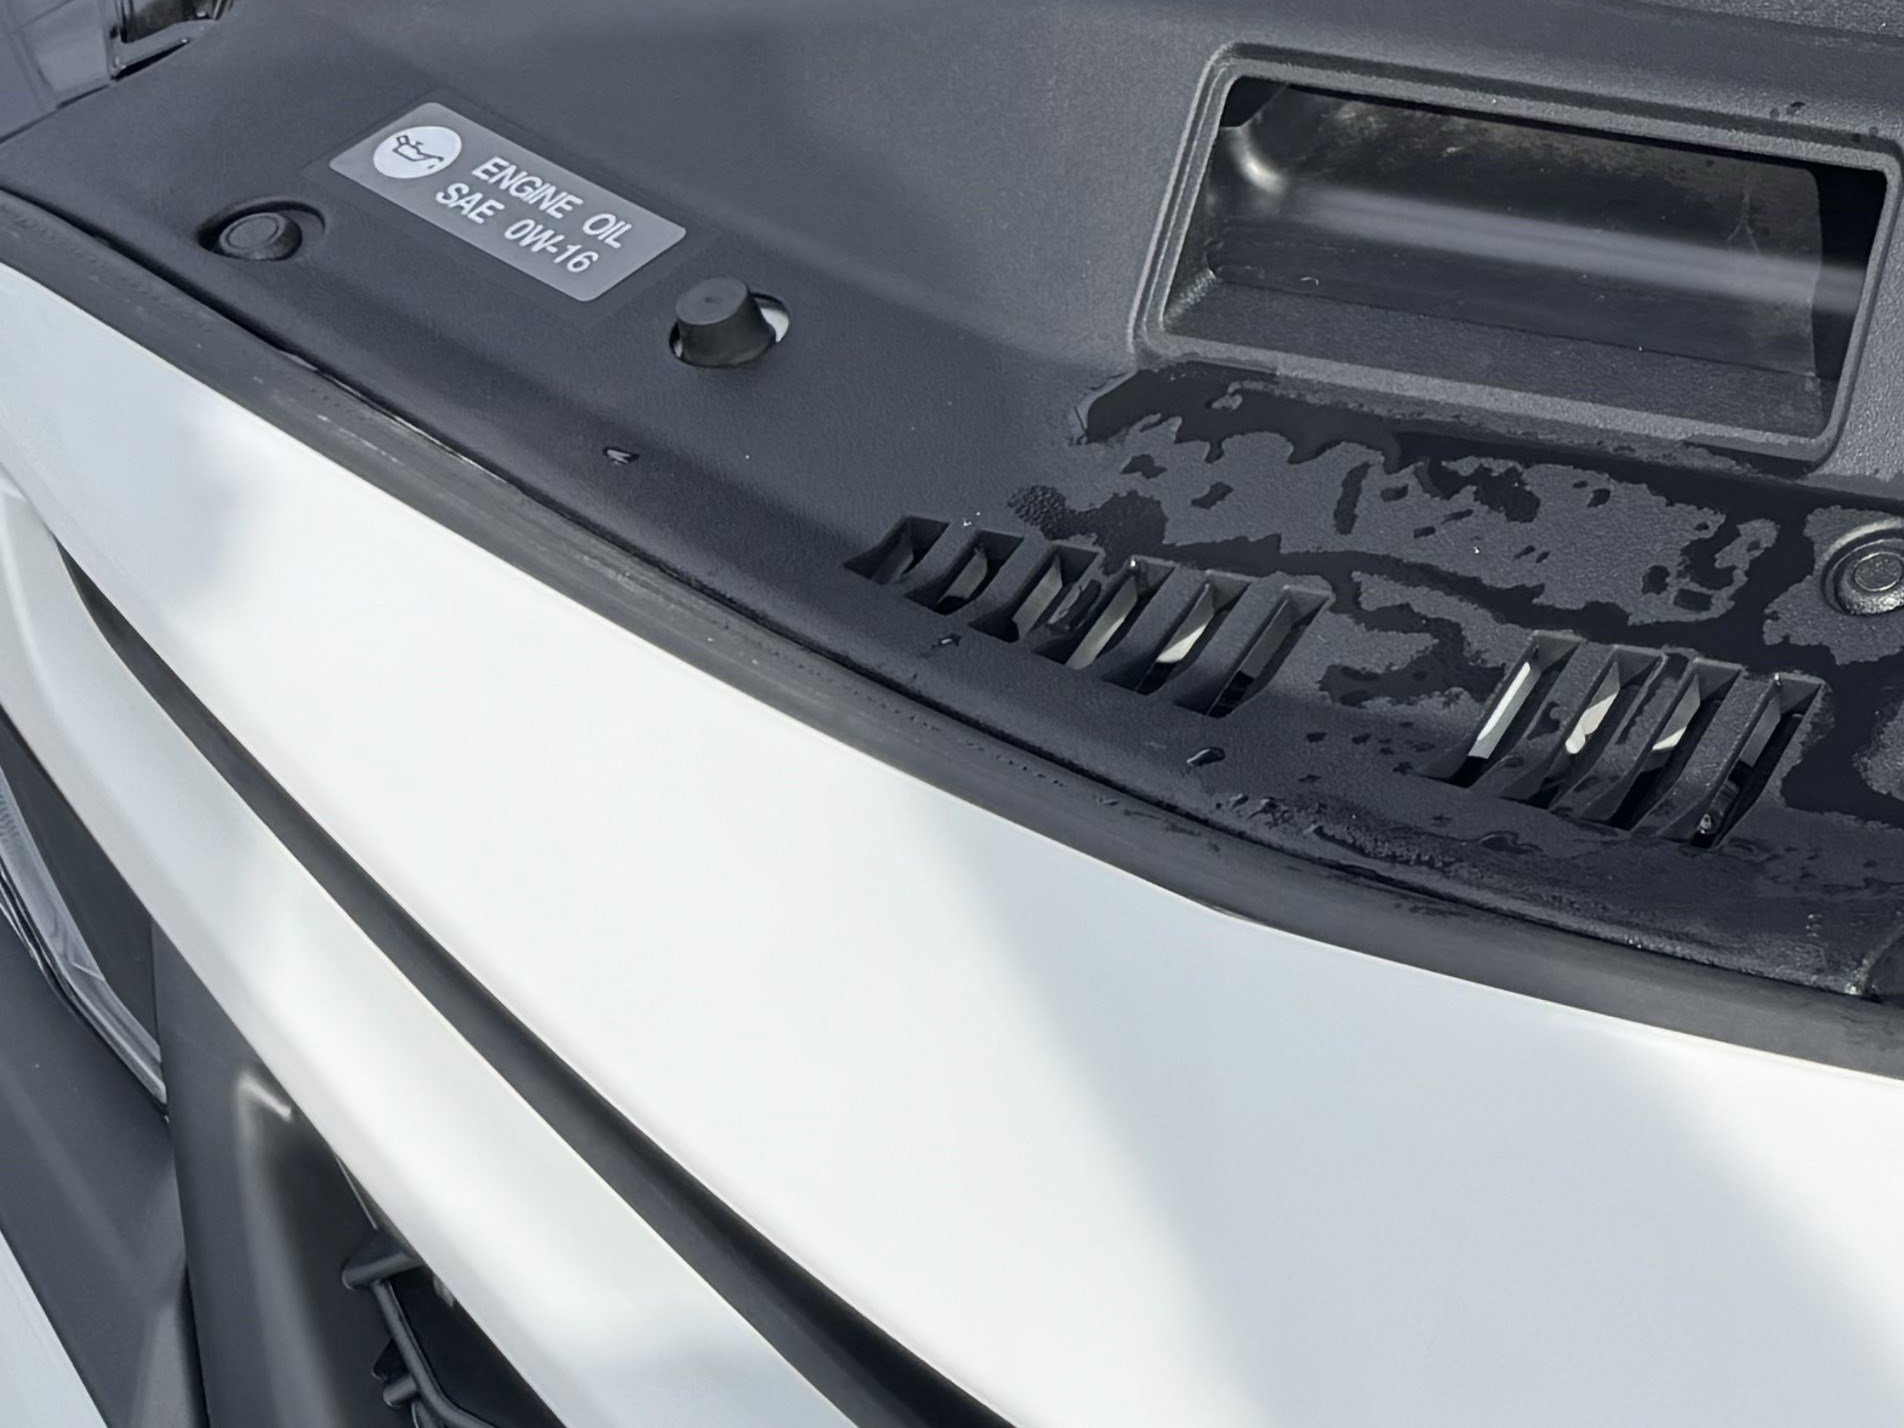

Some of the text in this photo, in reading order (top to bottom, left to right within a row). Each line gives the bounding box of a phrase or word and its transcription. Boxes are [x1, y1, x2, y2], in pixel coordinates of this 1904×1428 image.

[435, 182, 599, 274] SAE 0W-16
[471, 156, 633, 248] ENGINE OIL
